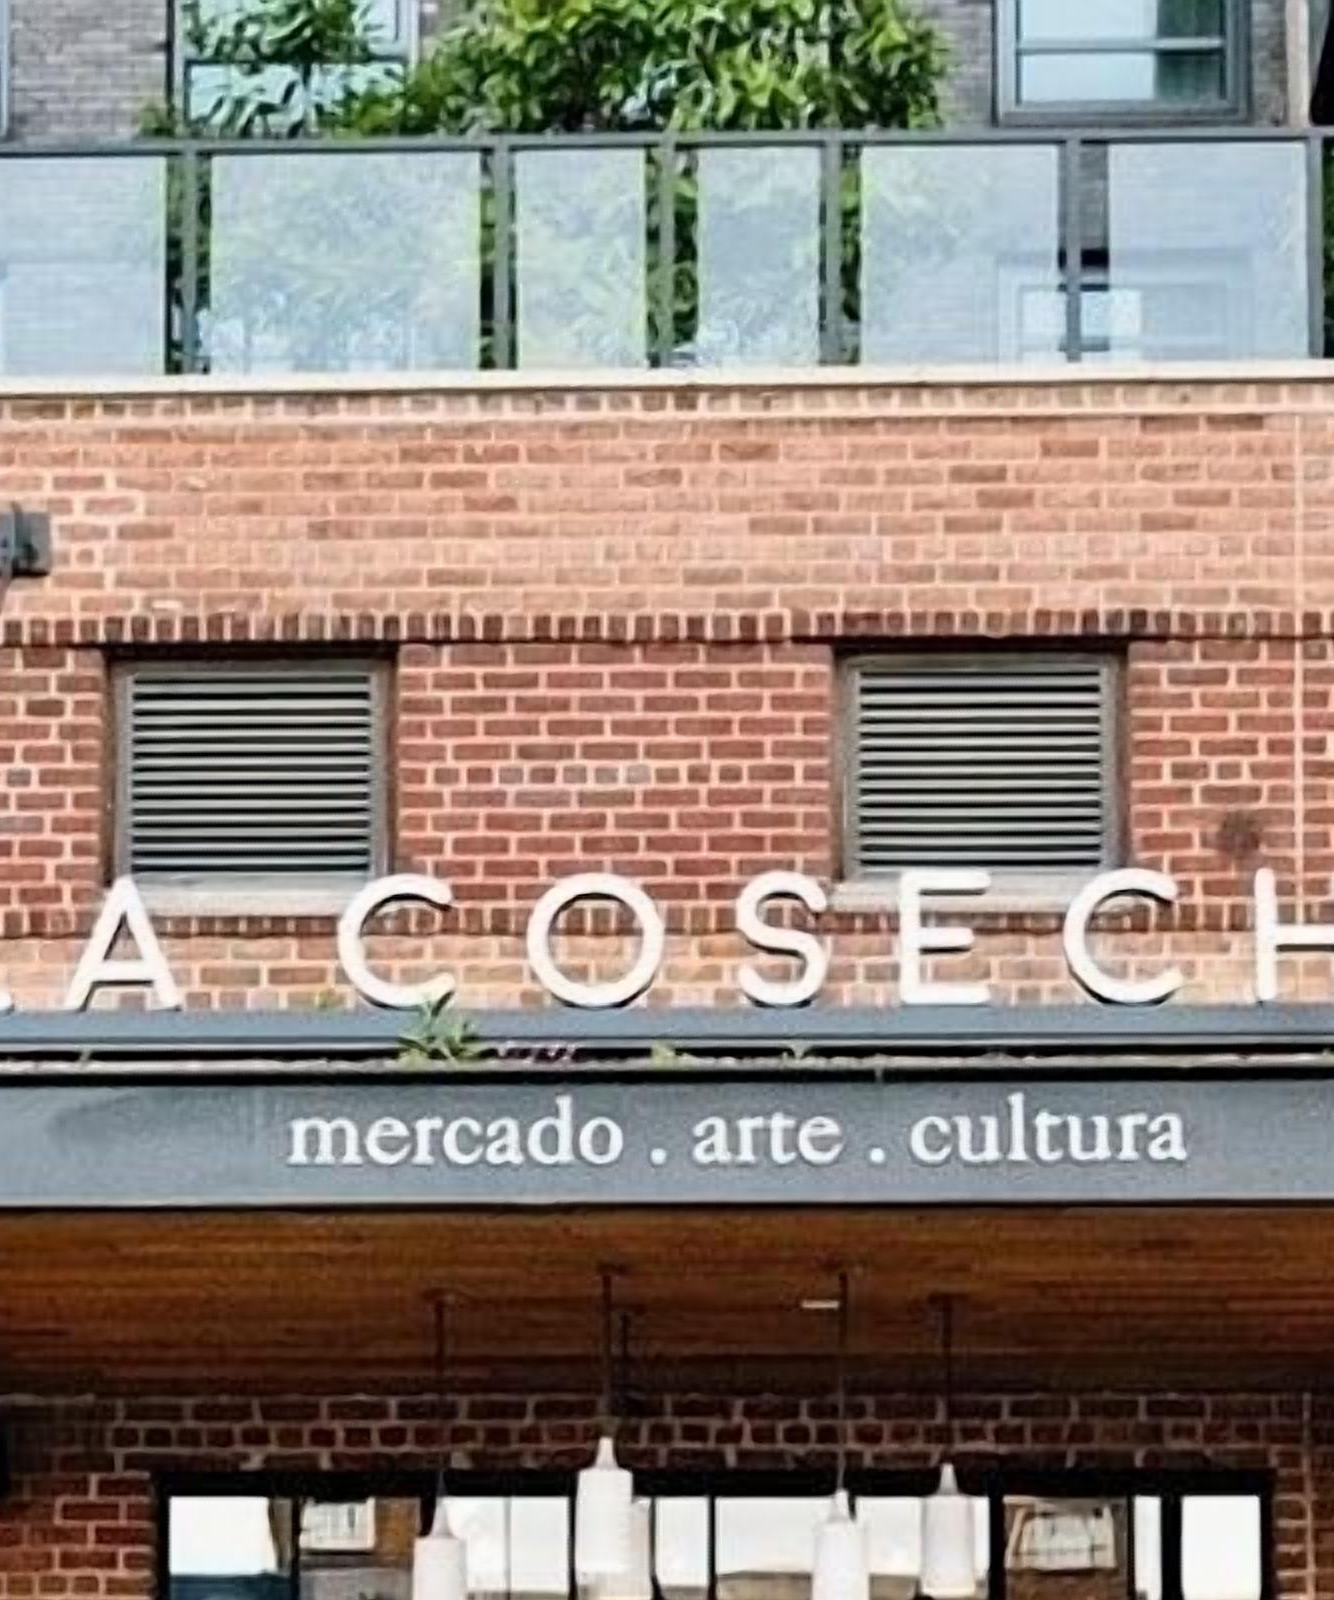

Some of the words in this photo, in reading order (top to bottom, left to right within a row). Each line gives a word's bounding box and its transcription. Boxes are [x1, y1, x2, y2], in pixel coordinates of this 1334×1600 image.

[287, 1091, 625, 1166] mercado
[690, 1110, 843, 1165] arte
[909, 1091, 1189, 1164] cultura
